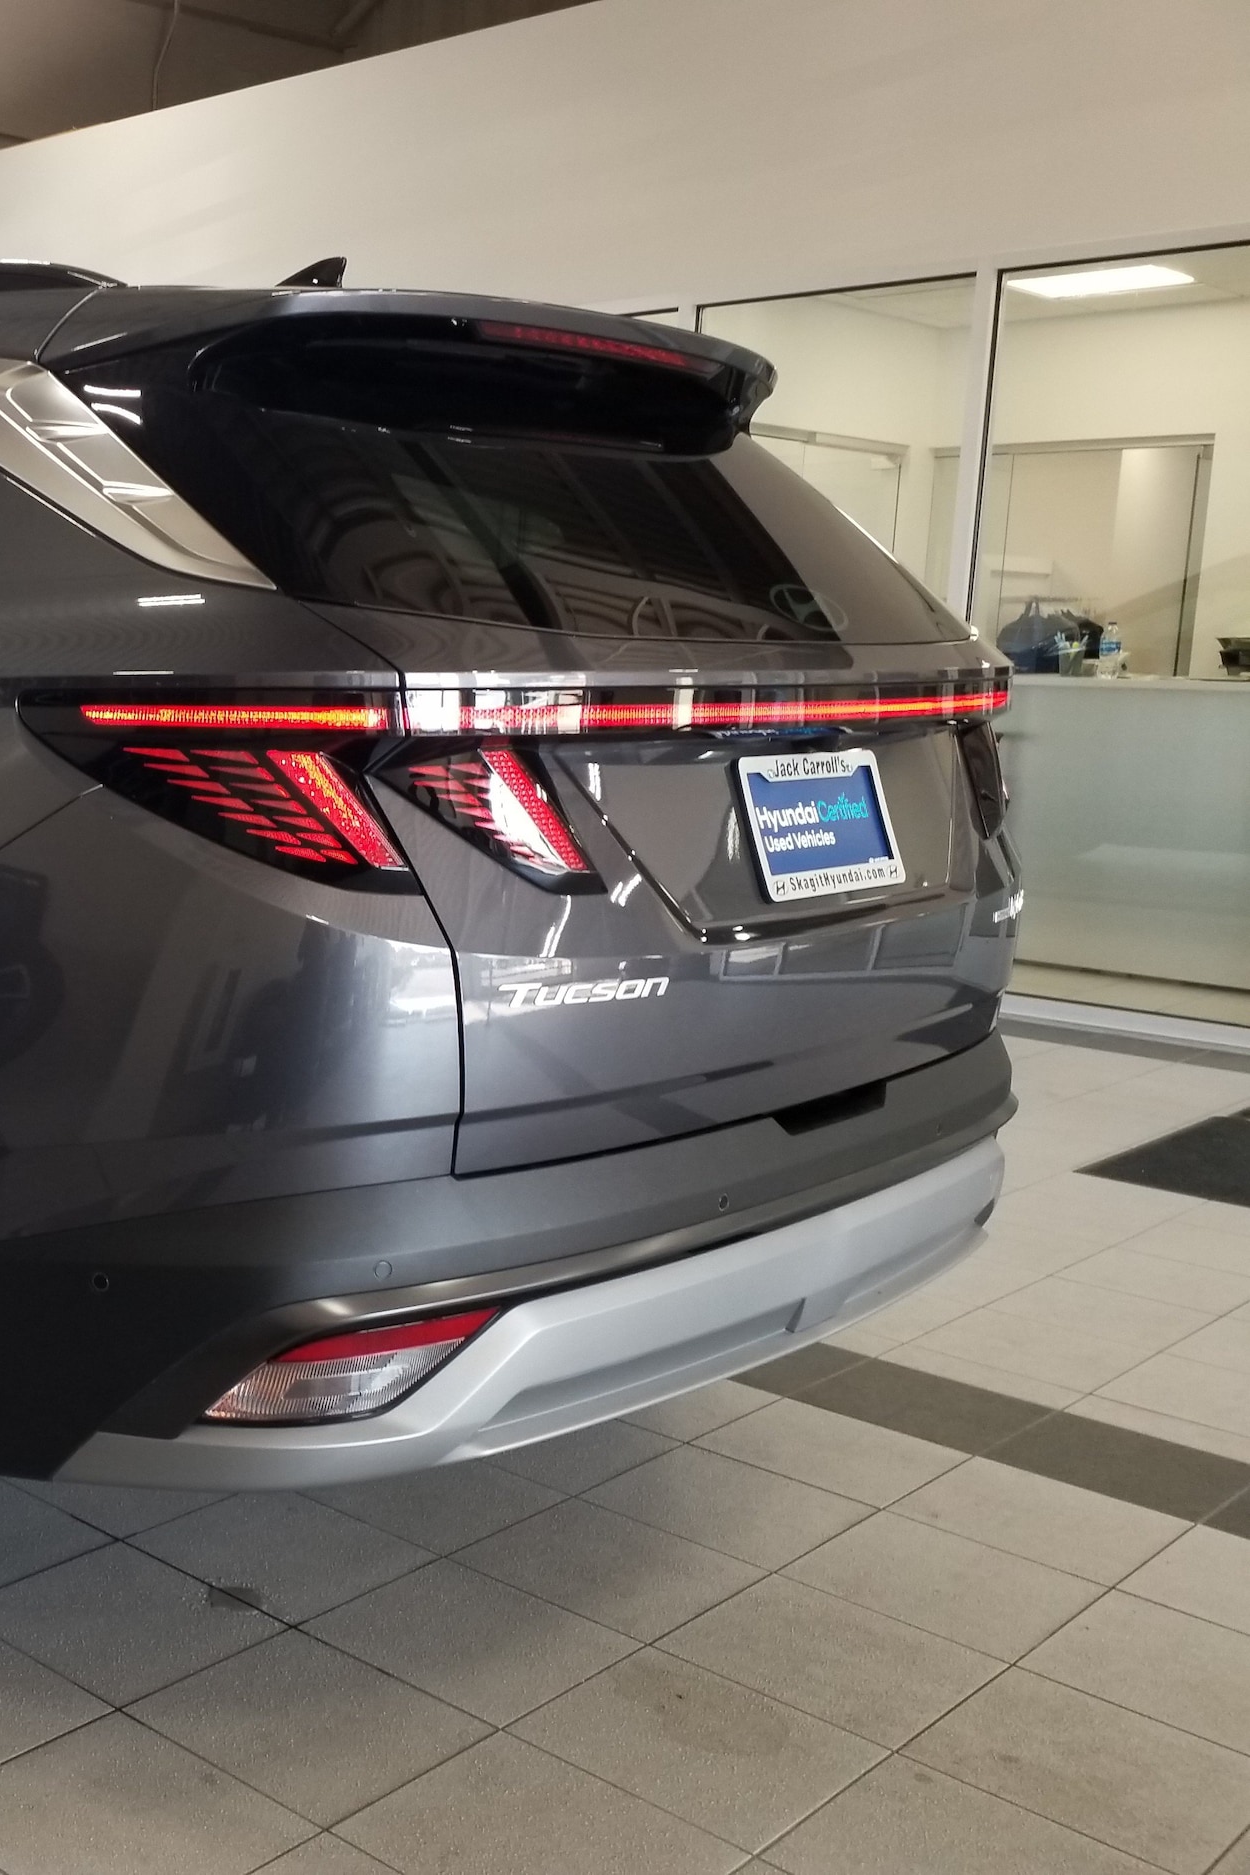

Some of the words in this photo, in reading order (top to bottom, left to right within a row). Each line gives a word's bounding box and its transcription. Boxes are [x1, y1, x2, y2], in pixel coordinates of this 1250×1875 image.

[774, 758, 800, 778] Jack
[802, 755, 847, 777] Carroll's
[755, 800, 819, 832] Hyundai
[816, 792, 869, 822] Certified
[764, 832, 794, 853] Used
[794, 828, 836, 850] Vehicles
[789, 866, 886, 892] SkagitHyundai.com
